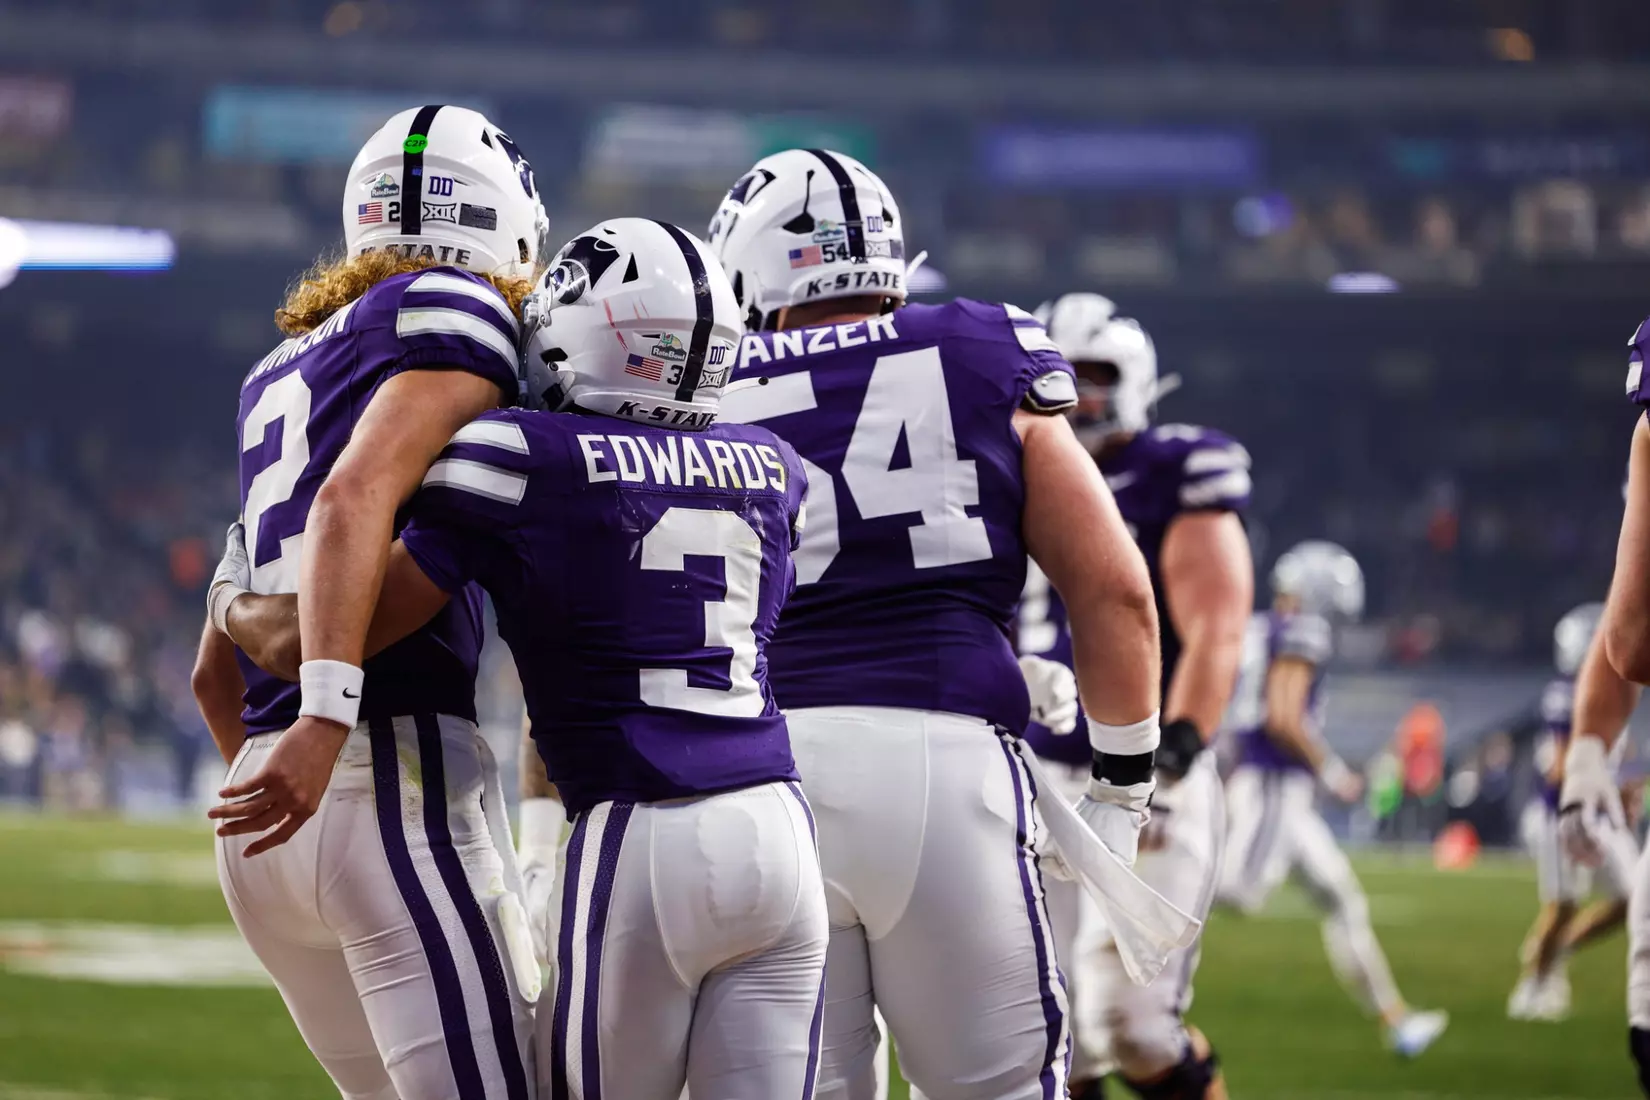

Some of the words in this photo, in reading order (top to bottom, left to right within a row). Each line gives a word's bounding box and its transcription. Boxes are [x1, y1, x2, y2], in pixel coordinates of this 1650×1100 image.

[428, 176, 454, 196] DD
[388, 202, 400, 222] 2
[822, 242, 850, 263] 54
[806, 271, 900, 298] K-STATE
[739, 312, 899, 369] ANZER
[708, 346, 725, 365] DD
[667, 365, 683, 385] 3
[616, 401, 717, 427] K-STATE
[577, 434, 786, 493] EDWARDS
[243, 368, 313, 594] 2
[640, 507, 766, 718] 3
